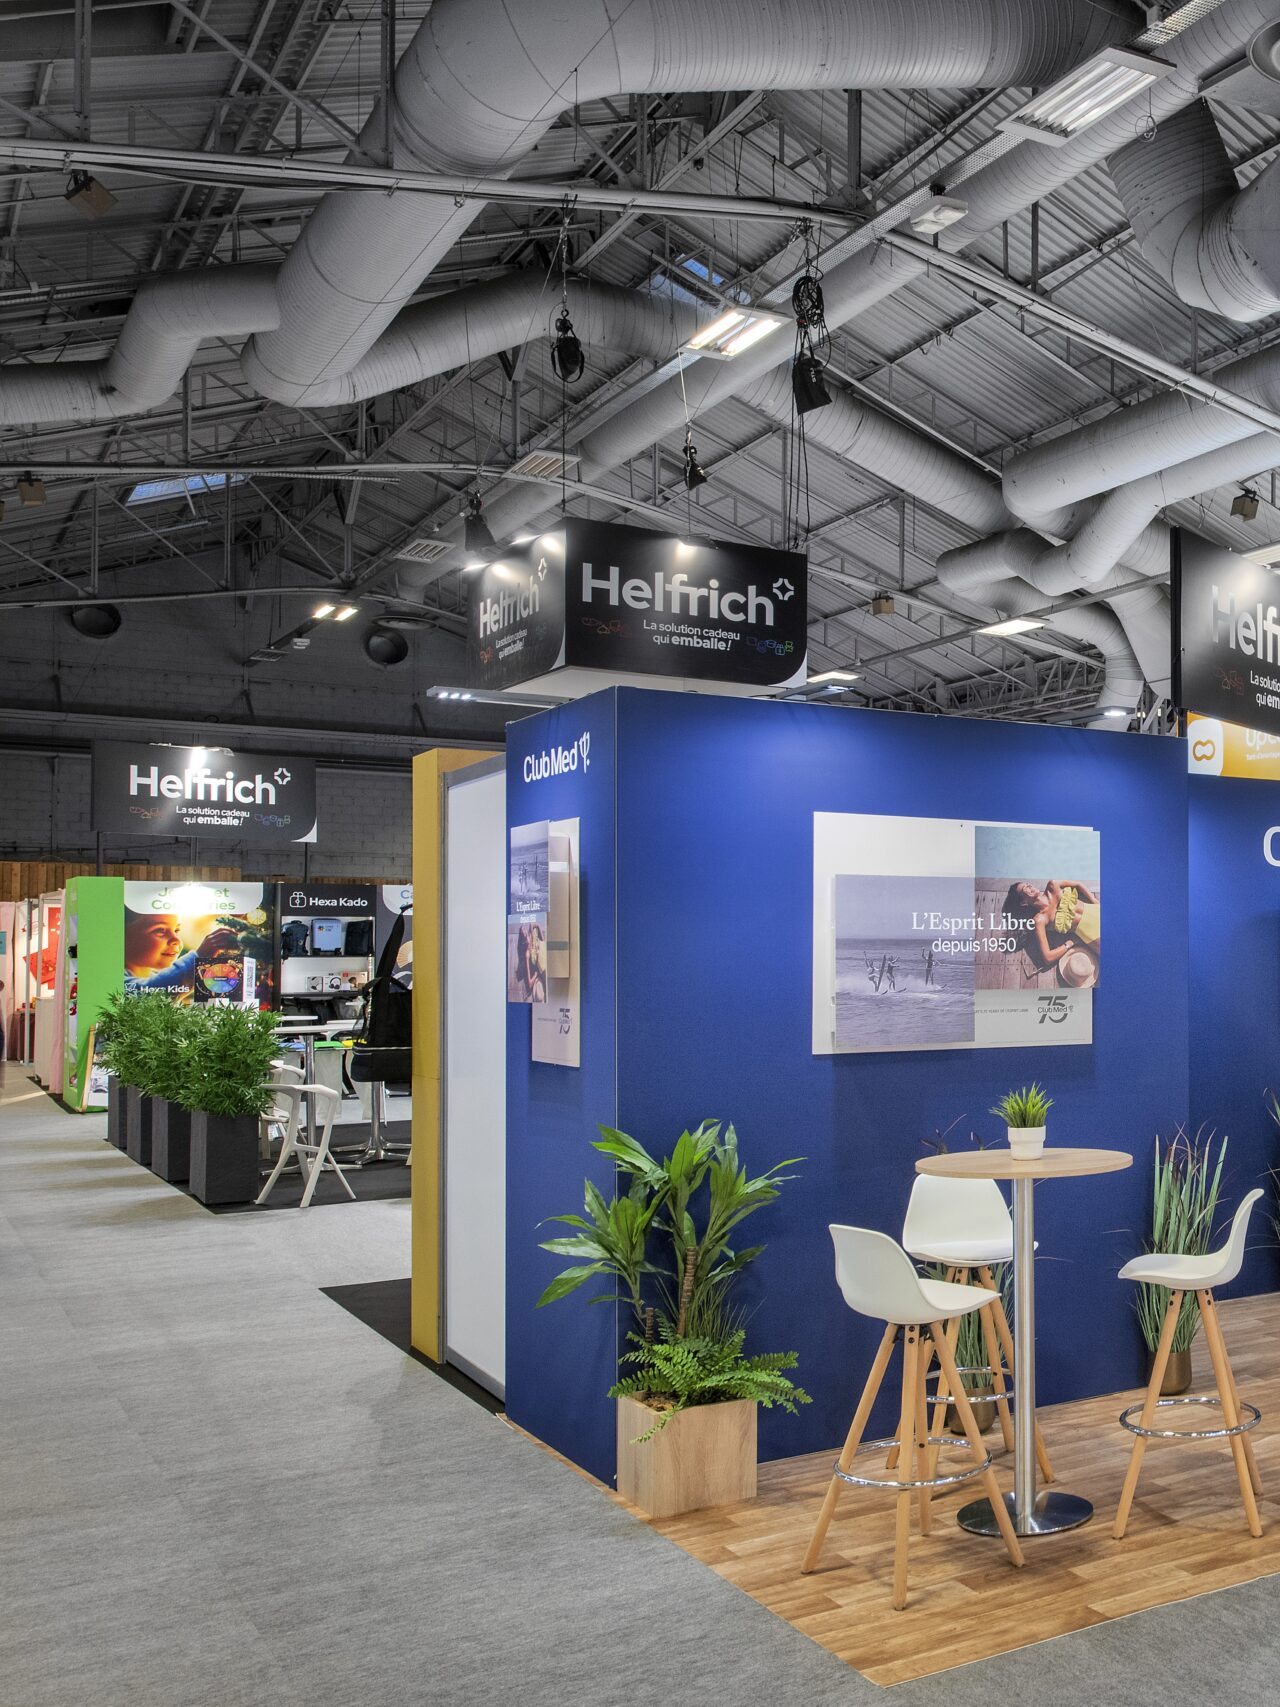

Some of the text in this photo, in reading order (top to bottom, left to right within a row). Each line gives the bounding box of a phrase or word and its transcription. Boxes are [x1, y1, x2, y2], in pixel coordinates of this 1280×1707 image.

[582, 562, 774, 626] Helfrich
[480, 576, 539, 638] Helfrich
[644, 620, 740, 640] La solution cadeau
[652, 634, 670, 645] qui
[1250, 670, 1259, 685] La
[1256, 692, 1266, 706] qui
[524, 741, 578, 783] Club Med
[130, 764, 276, 805] Helfrich
[176, 806, 250, 818] La solution cadeau
[183, 816, 196, 824] qui
[309, 896, 368, 908] Hexa Kado
[911, 912, 1036, 937] L'Esprit Libre
[932, 937, 1016, 956] depuis 1950
[167, 985, 190, 993] Kids
